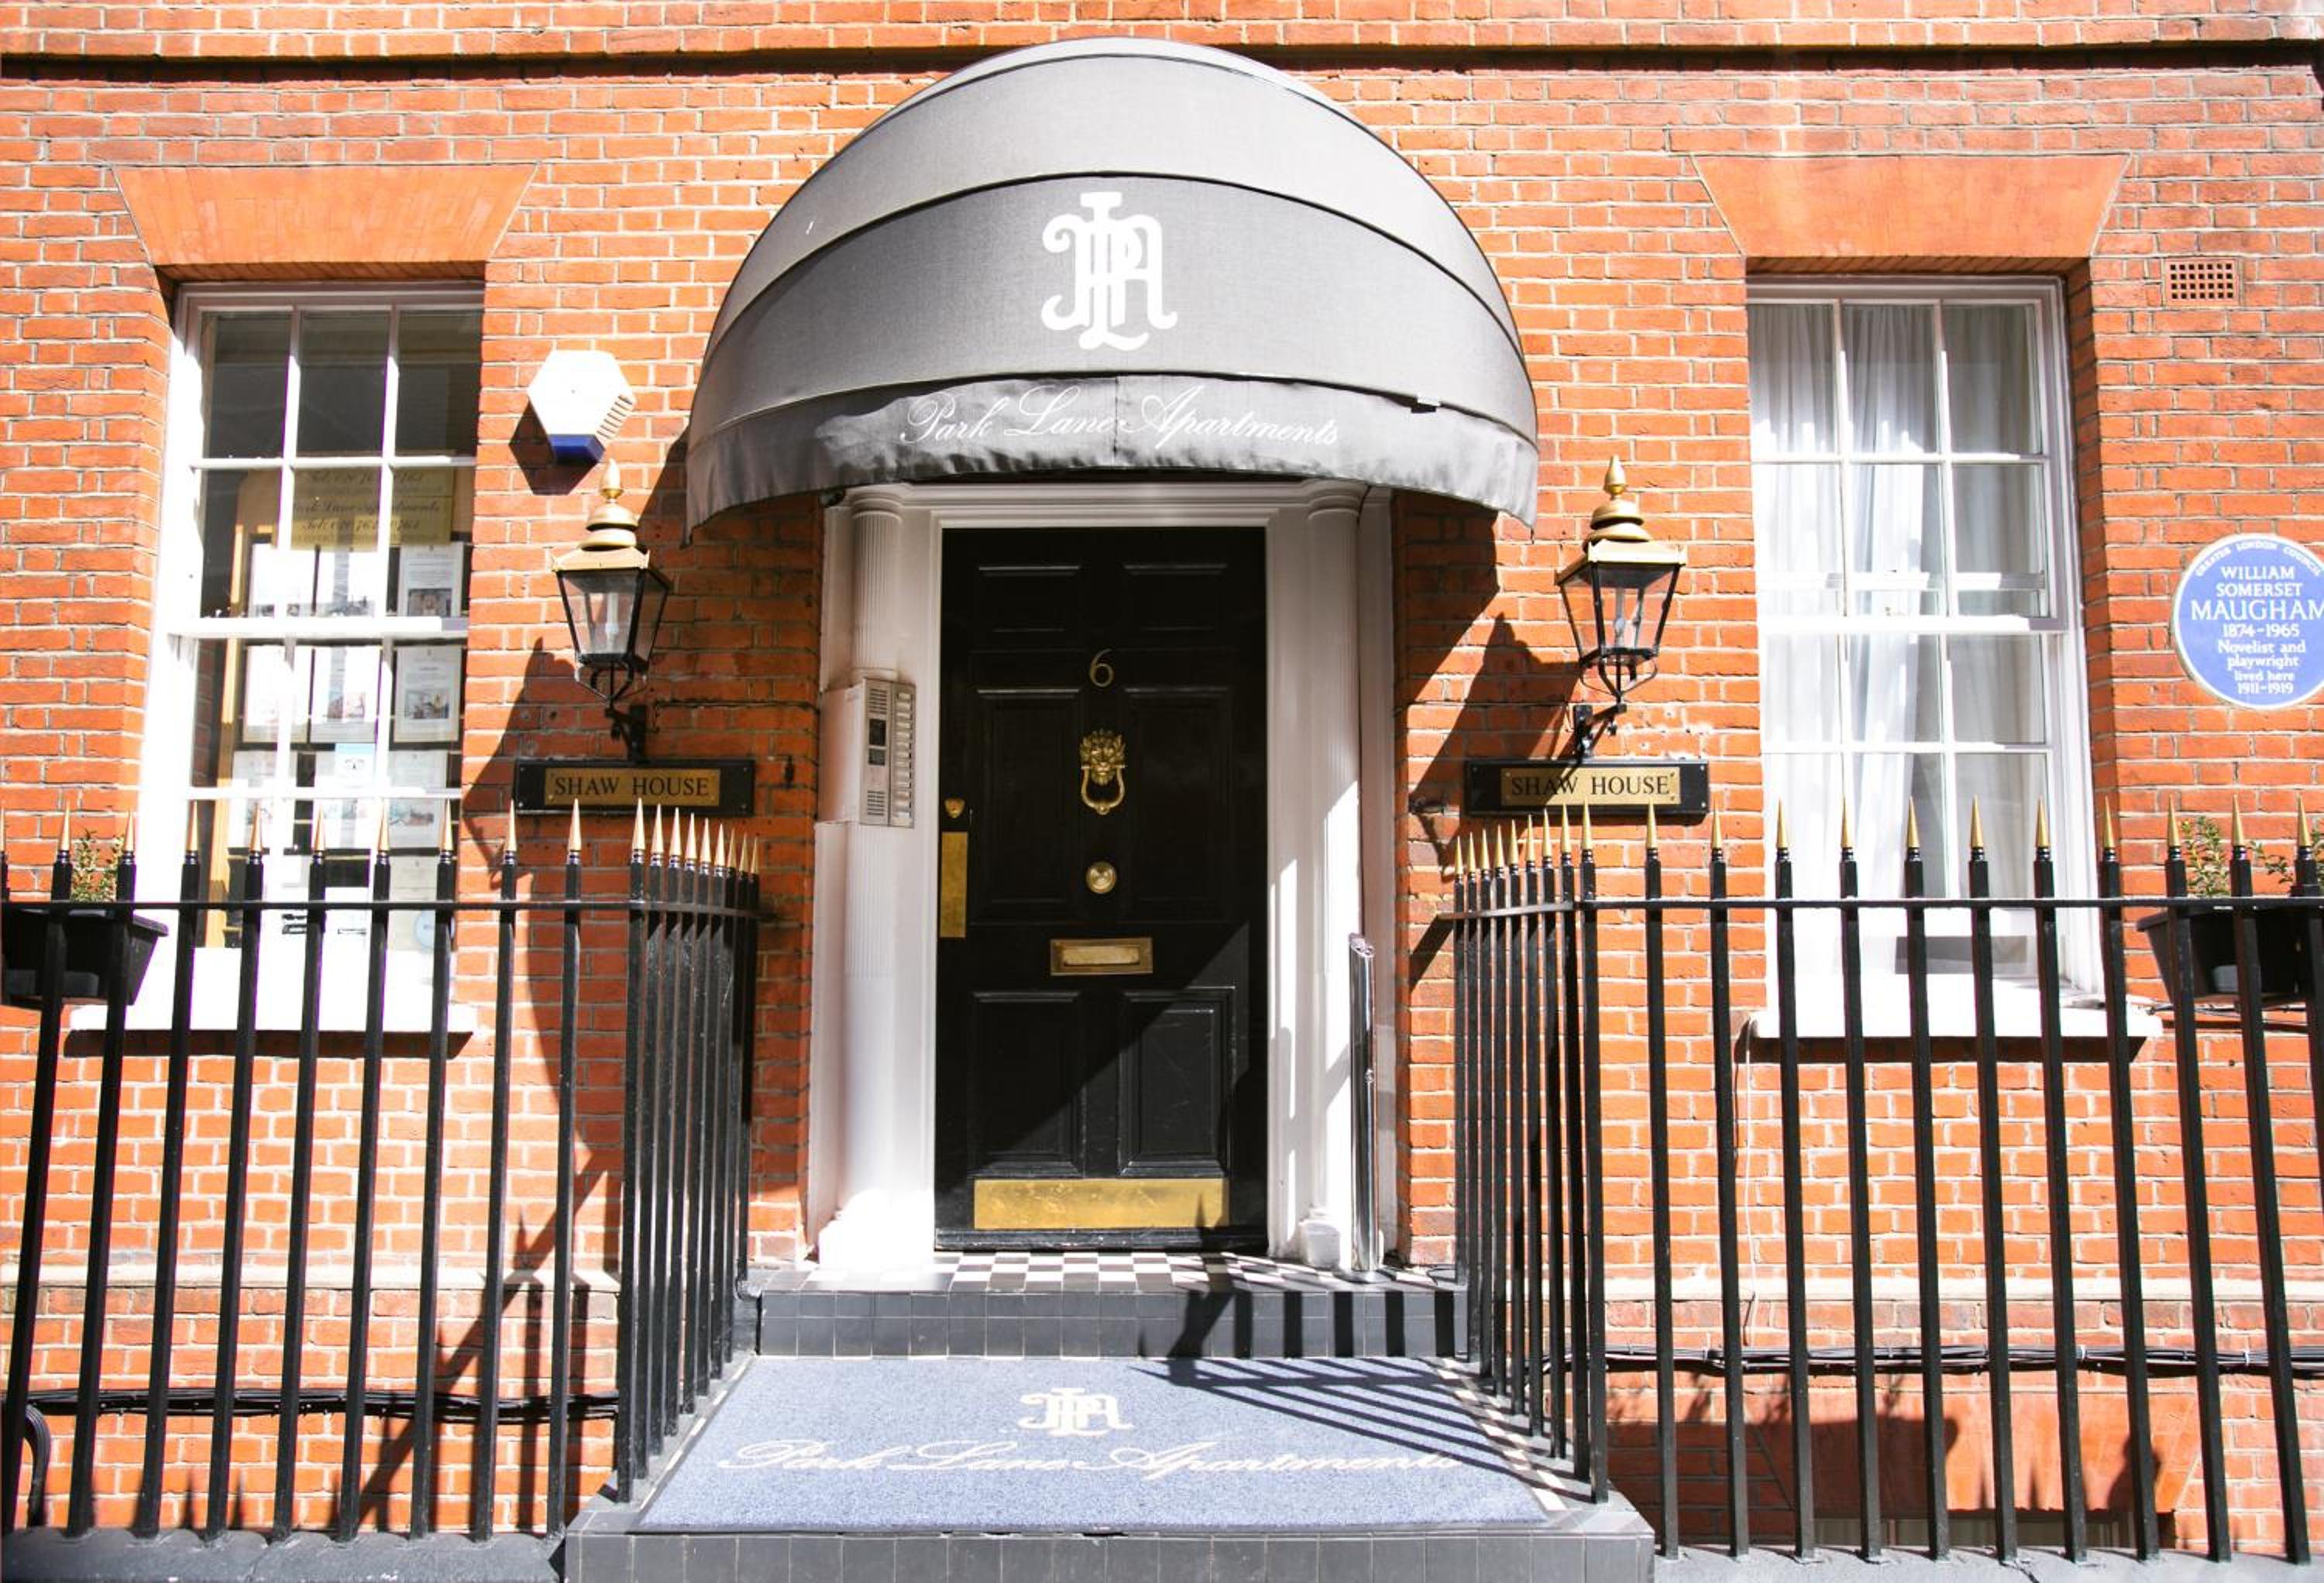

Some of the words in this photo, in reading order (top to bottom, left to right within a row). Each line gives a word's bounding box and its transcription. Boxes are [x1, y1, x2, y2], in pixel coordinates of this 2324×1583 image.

[899, 387, 1010, 445] Park
[1003, 385, 1116, 436] Lane
[1118, 384, 1339, 450] Apartments
[2220, 565, 2295, 581] WILLIAM
[2216, 582, 2304, 597] SOMERSET
[2191, 599, 2324, 620] MAUGHAM
[2218, 639, 2275, 654] Novelist
[2280, 639, 2306, 653] and
[1090, 648, 1113, 688] 6
[2226, 654, 2300, 671] playwright
[2234, 670, 2264, 682] lived
[2267, 670, 2295, 682] here
[555, 776, 619, 796] SHAW
[632, 776, 710, 797] HOUSE
[1511, 776, 1578, 796] SHAW
[1590, 775, 1670, 796] HOUSE
[718, 1439, 913, 1471] Park
[887, 1440, 1070, 1471] Lane
[1072, 1440, 1464, 1481] Apartments
